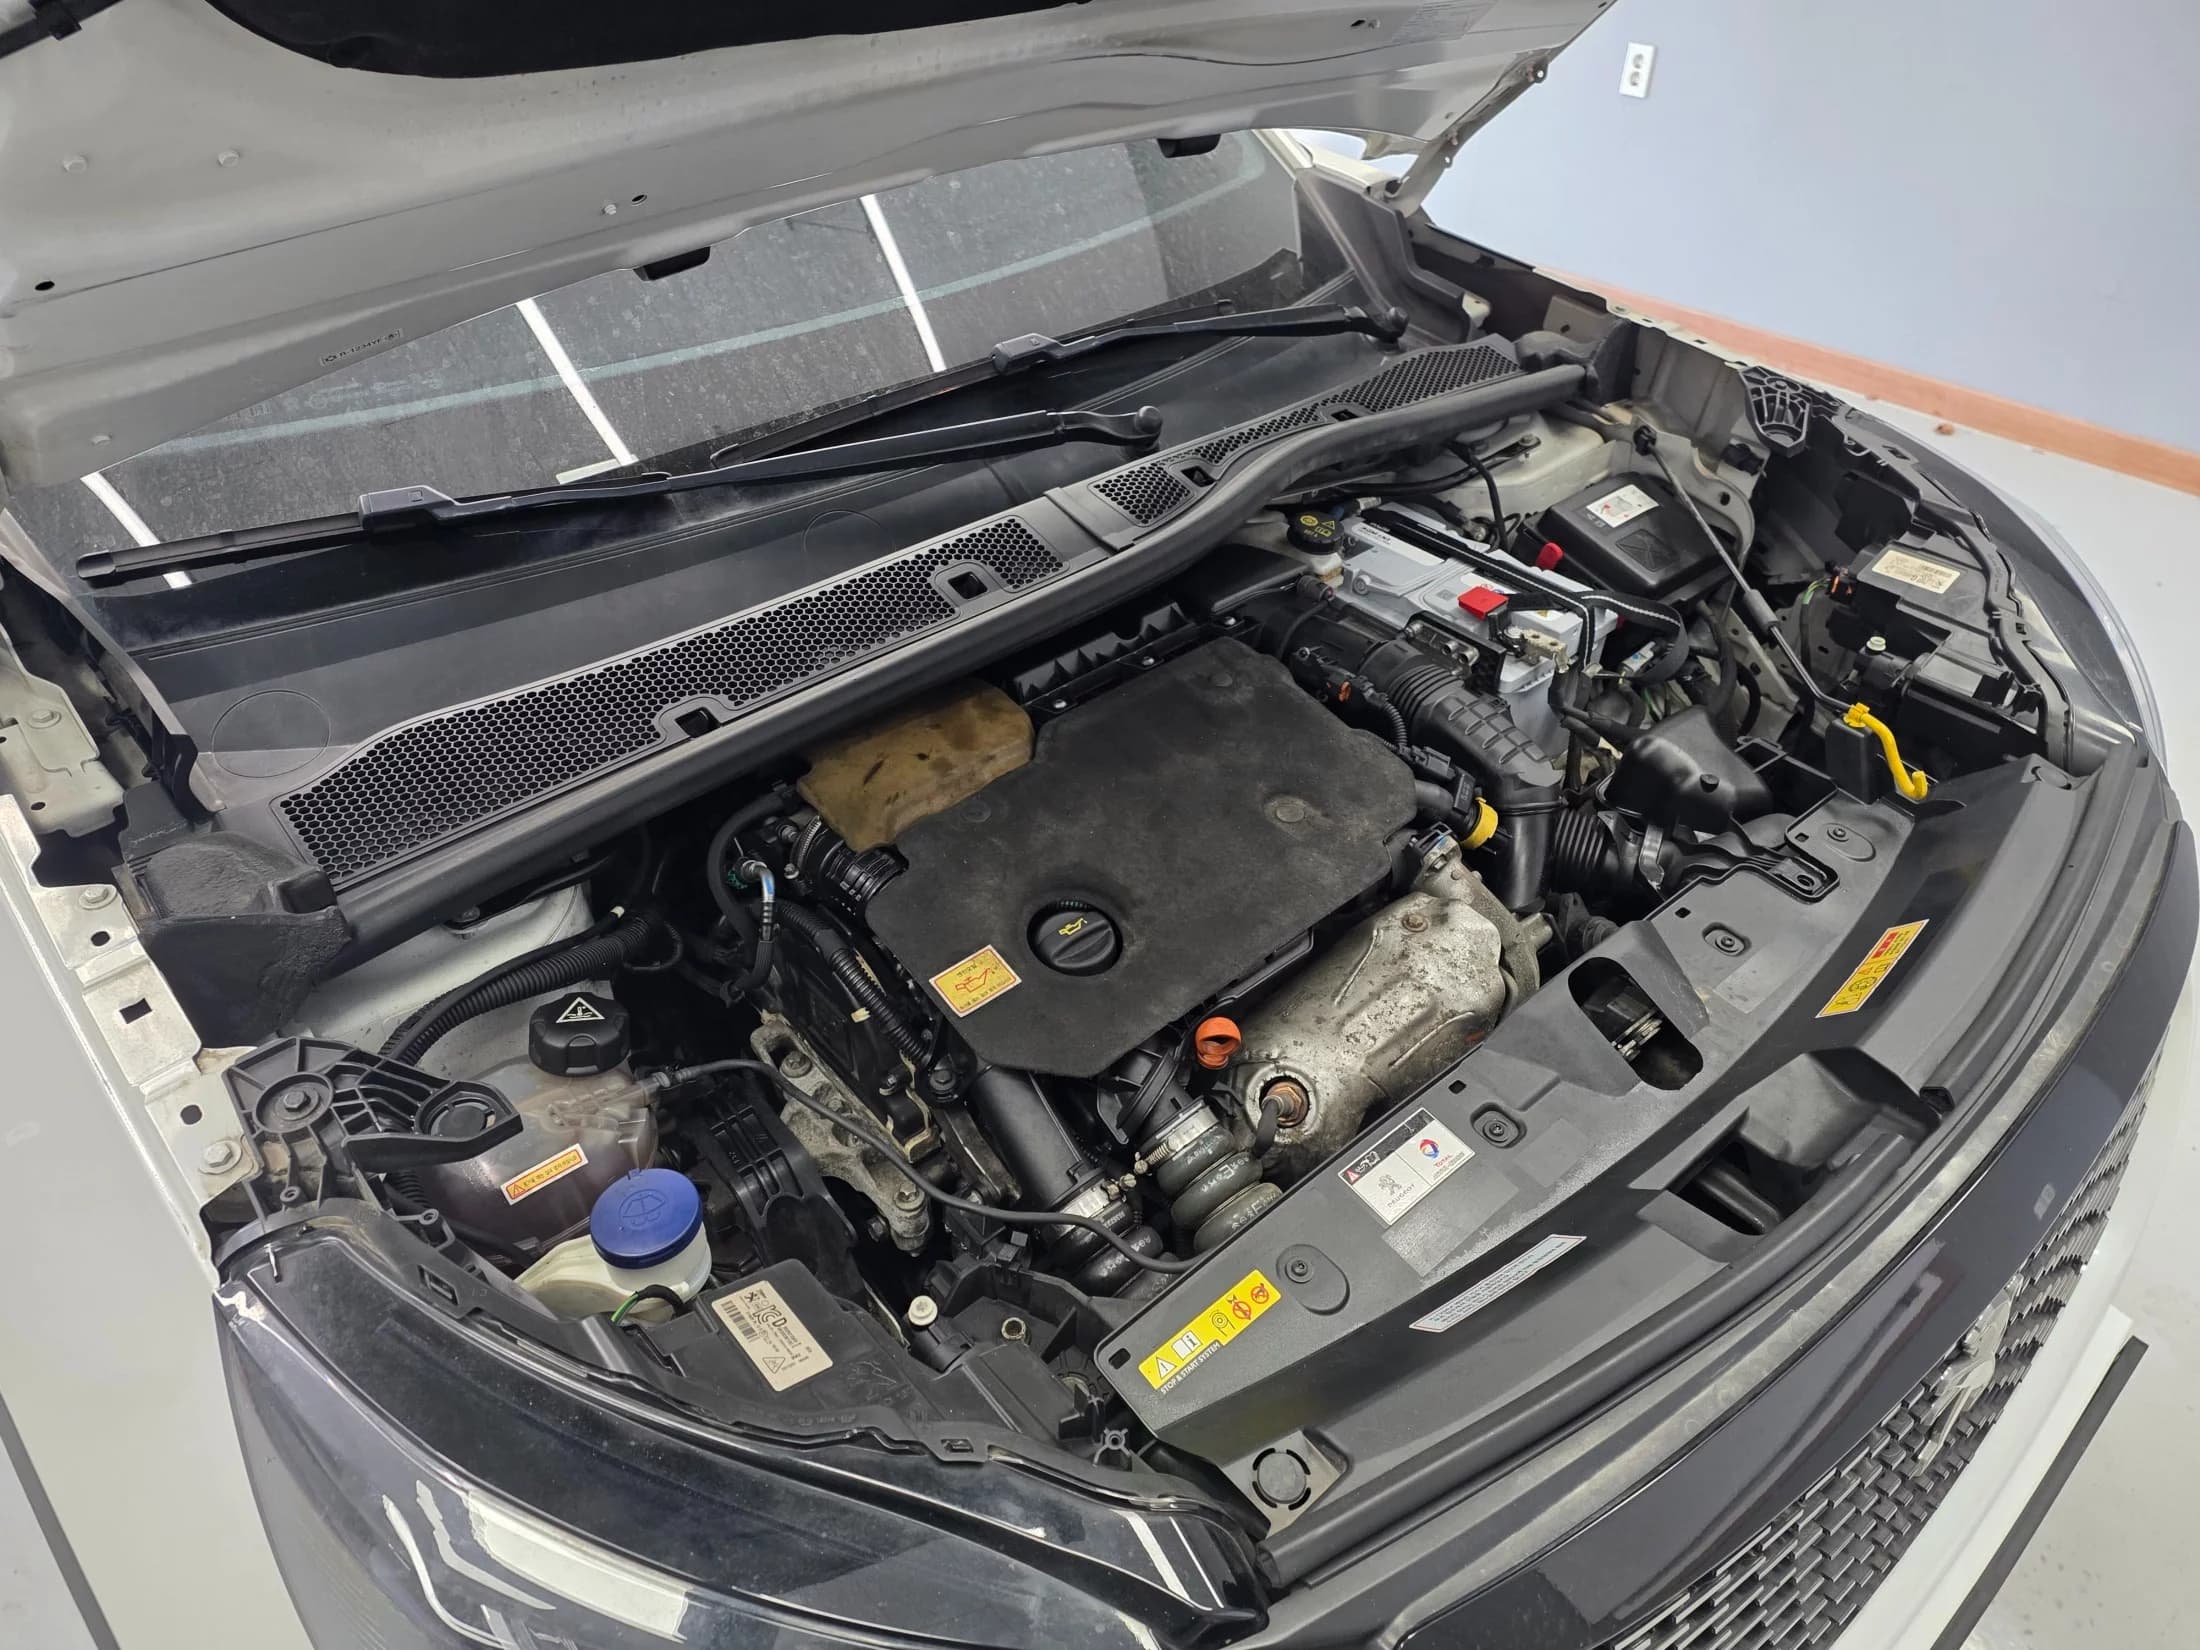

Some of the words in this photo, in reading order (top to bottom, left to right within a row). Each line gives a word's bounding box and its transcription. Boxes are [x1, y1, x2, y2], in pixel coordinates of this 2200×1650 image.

[1433, 1154, 1452, 1168] TOTAL
[1387, 1183, 1415, 1208] PEUGEOT
[1160, 1378, 1177, 1395] STOP
[1175, 1374, 1183, 1382] &
[1180, 1358, 1200, 1378] START
[1198, 1341, 1221, 1363] SYSTEM
